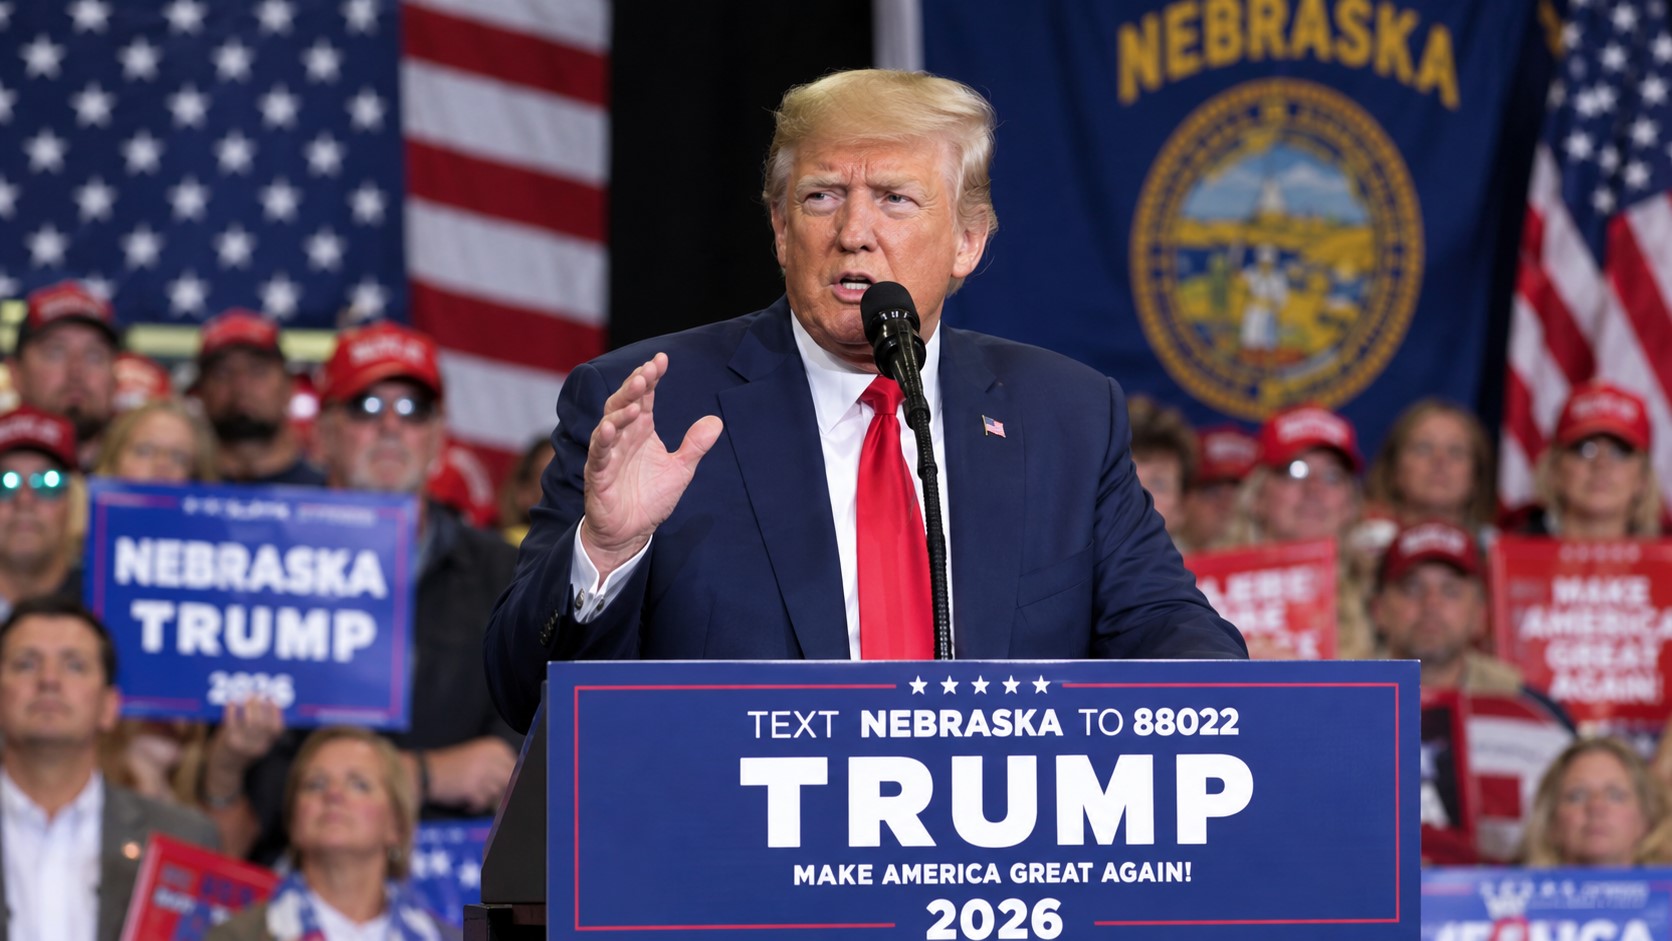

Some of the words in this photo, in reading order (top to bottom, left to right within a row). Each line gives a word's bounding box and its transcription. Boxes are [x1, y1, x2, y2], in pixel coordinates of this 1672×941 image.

[1117, 0, 1460, 109] NEBRASKA
[114, 535, 388, 599] NEBRASKA
[1551, 575, 1650, 605] MAKE
[130, 599, 378, 663] TRUMP
[1545, 638, 1660, 670] GREAT
[747, 707, 840, 739] TEXT
[860, 707, 1064, 738] NEBRASKA
[1078, 707, 1124, 737] TO
[1133, 706, 1240, 737] 88022
[739, 753, 1254, 849] TRUMP
[793, 863, 873, 886] MAKE
[881, 862, 1002, 885] AMERICA
[1009, 862, 1094, 885] GREAT
[1101, 861, 1192, 884] AGAIN!
[926, 897, 1064, 941] 2026
